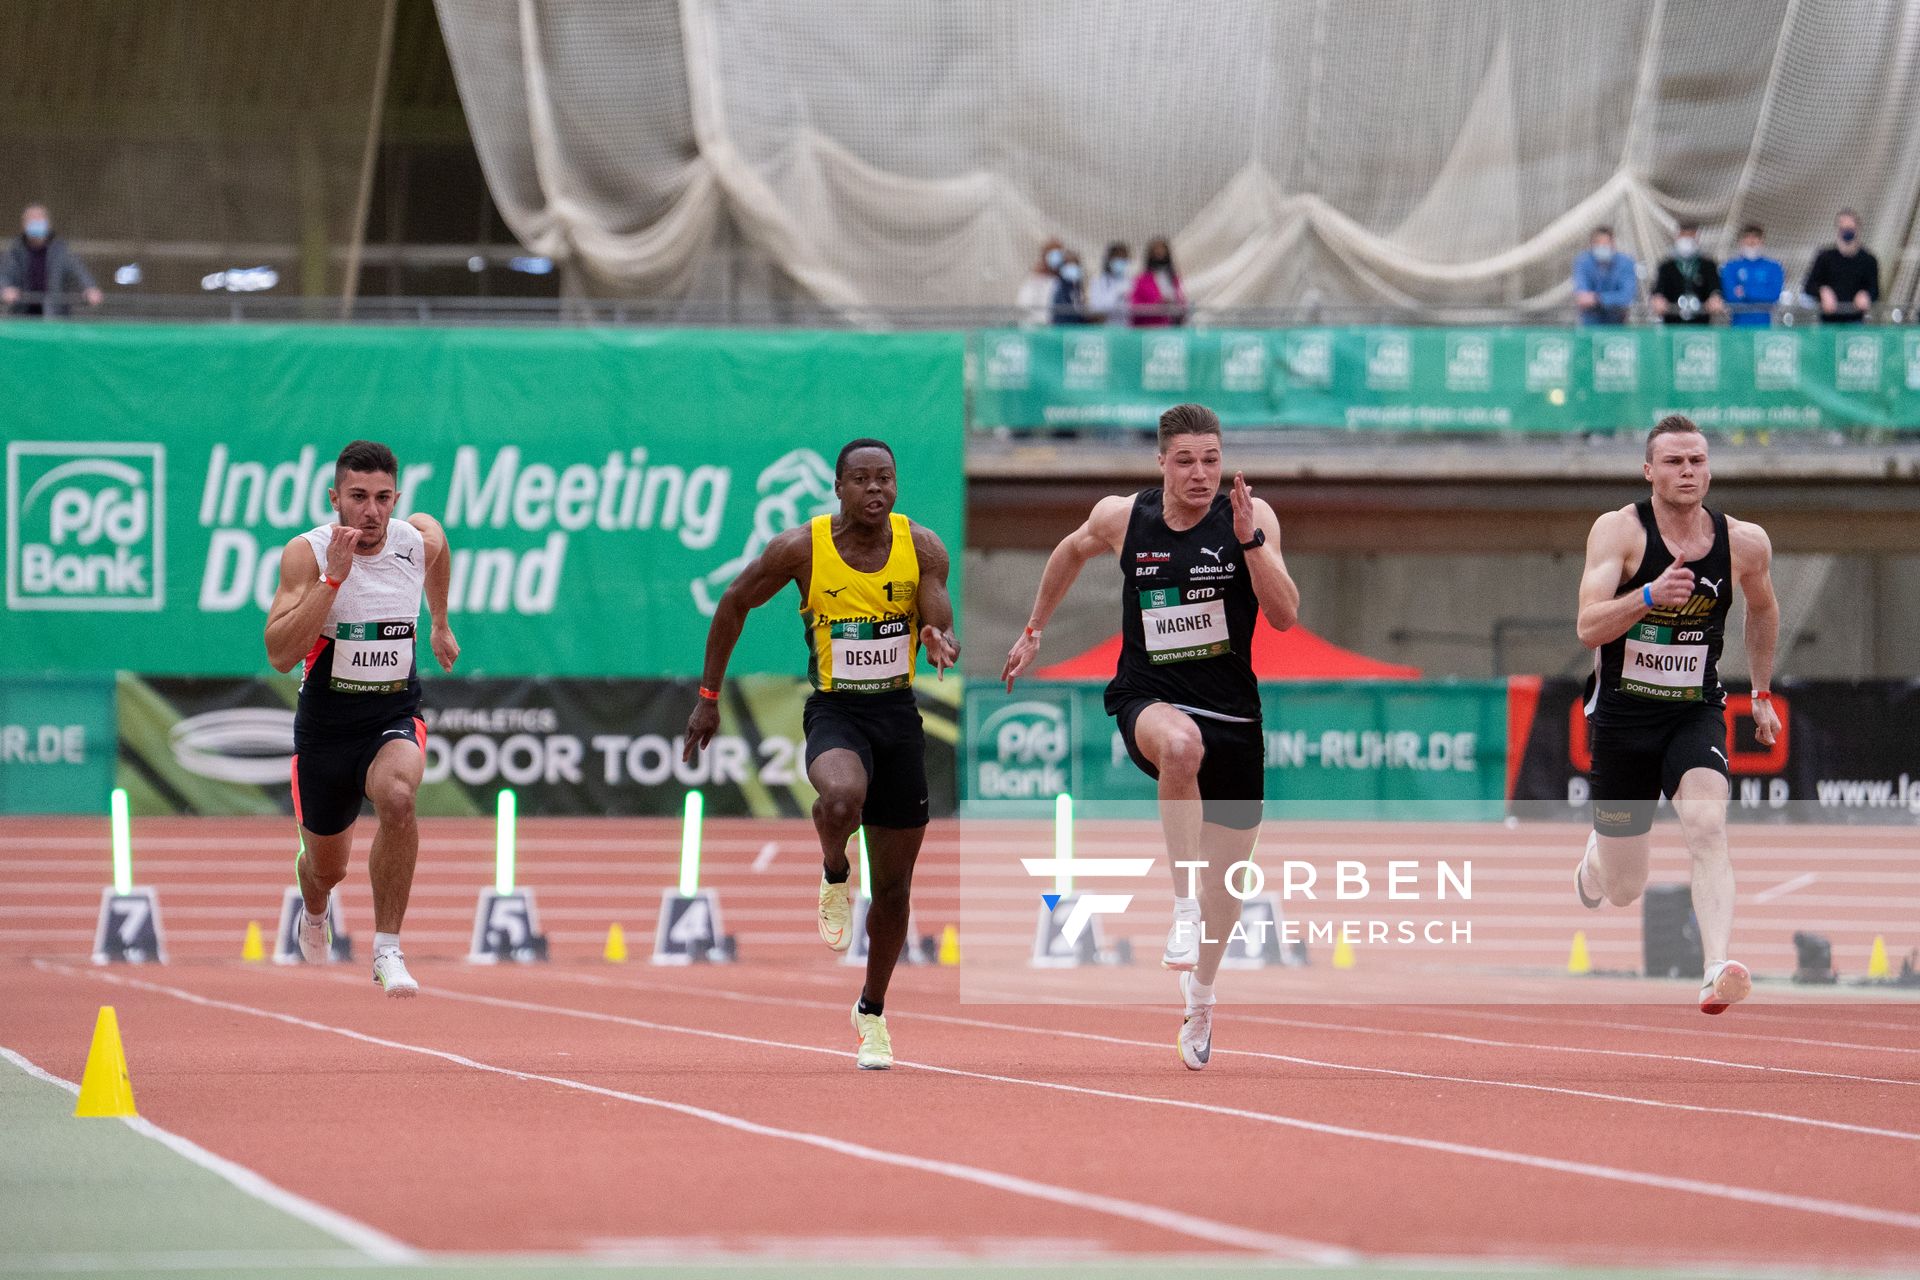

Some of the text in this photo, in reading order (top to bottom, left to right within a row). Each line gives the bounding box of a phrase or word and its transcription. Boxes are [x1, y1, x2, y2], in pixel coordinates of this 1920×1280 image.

[199, 443, 732, 549] Indor Meeting
[1151, 551, 1171, 559] TEAM
[22, 544, 148, 594] Bank
[1189, 565, 1223, 574] elobau
[1186, 587, 1215, 601] GfTD
[383, 625, 410, 636] GfTD
[879, 622, 903, 635] GfTD
[1155, 613, 1213, 635] WAGNER
[1677, 631, 1704, 641] GfTD
[351, 650, 399, 668] ALMAS
[845, 647, 898, 666] DESALU
[1152, 648, 1208, 661] DORTMUND 22
[1635, 652, 1698, 672] ASKOVIC
[337, 681, 380, 693] DORTMUND
[837, 681, 891, 691] DORTMUND 22
[1626, 682, 1671, 698] DORTMUND
[421, 733, 584, 786] DOOR
[591, 733, 750, 786] TOUR
[977, 760, 1067, 798] Bank
[112, 899, 148, 943] 7
[487, 899, 526, 946] 5
